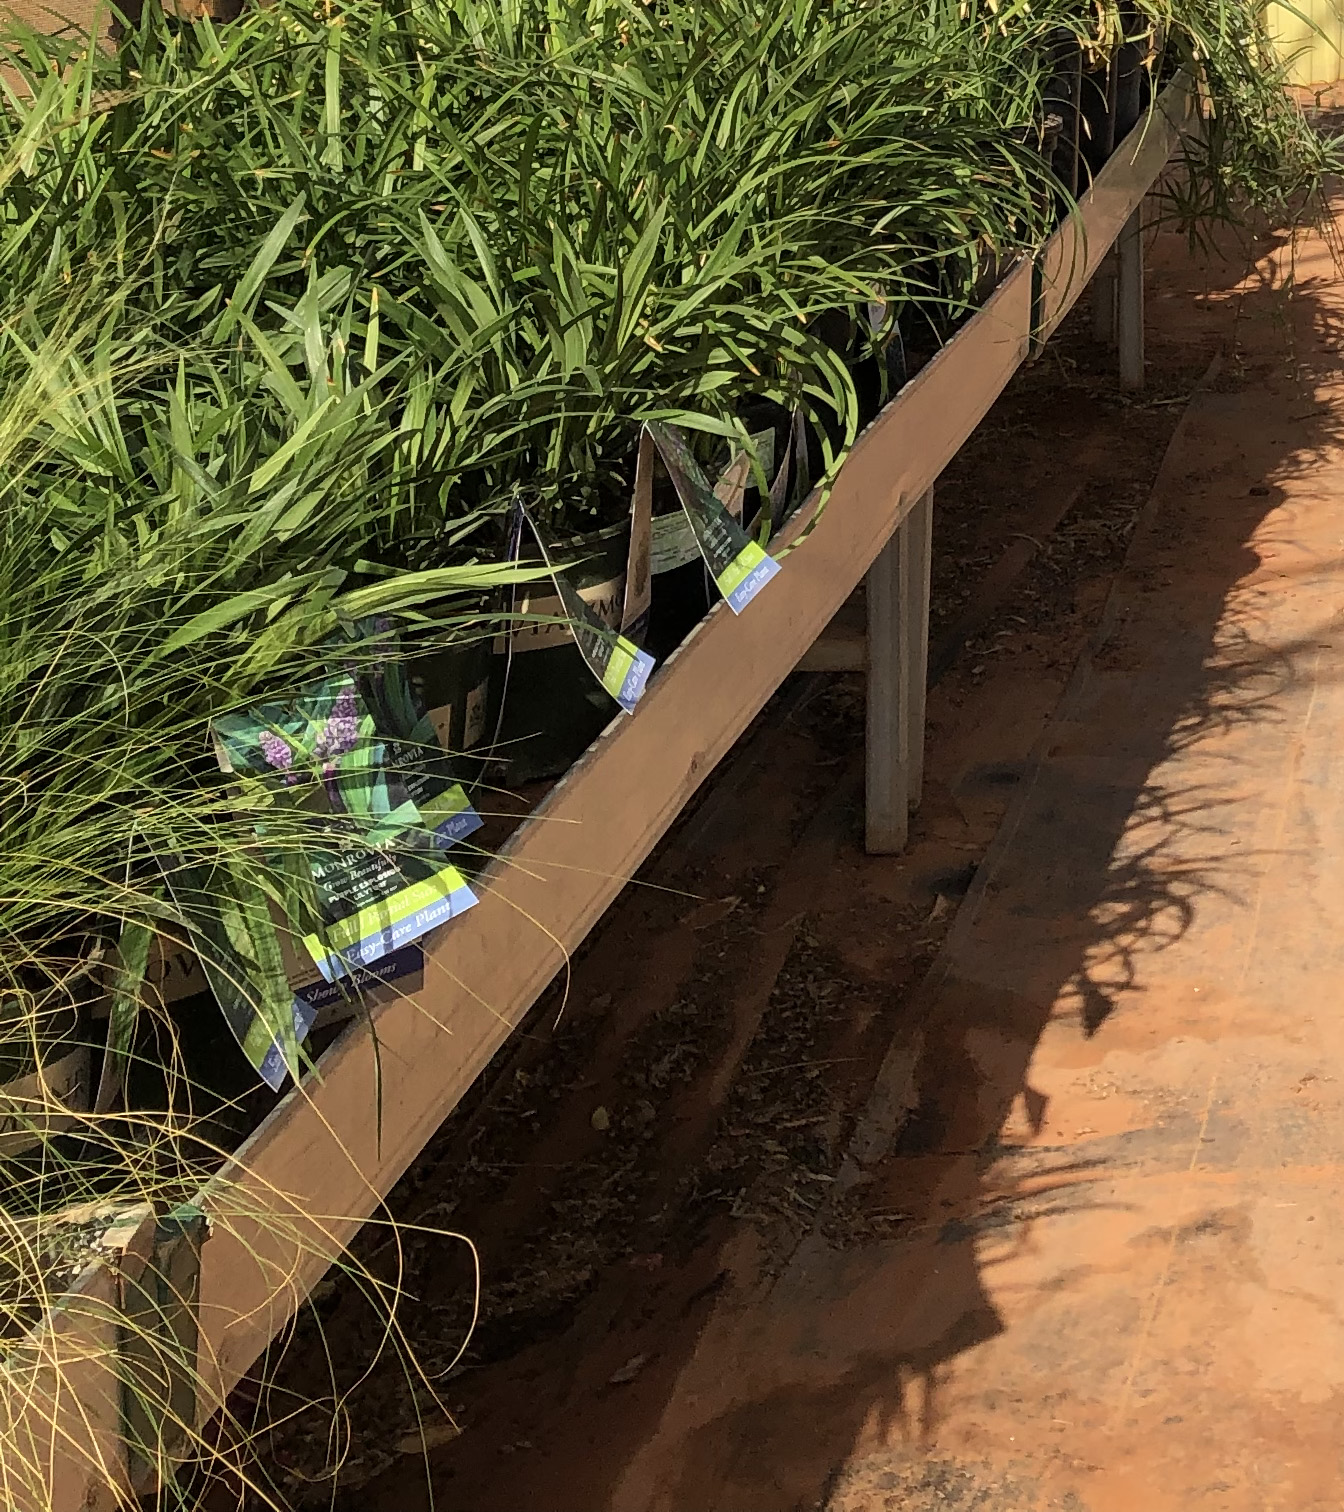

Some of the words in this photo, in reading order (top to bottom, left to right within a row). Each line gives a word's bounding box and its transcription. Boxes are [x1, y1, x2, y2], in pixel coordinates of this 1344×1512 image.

[312, 837, 396, 880] MONROVIA
[322, 873, 349, 892] Grow
[348, 852, 398, 882] Beautifully
[327, 884, 359, 903] PURPLE
[366, 895, 411, 922] Partial
[413, 883, 438, 901] Sun
[345, 922, 413, 964] Easy-Care
[415, 901, 452, 928] Plant
[351, 962, 398, 989] Blooms
